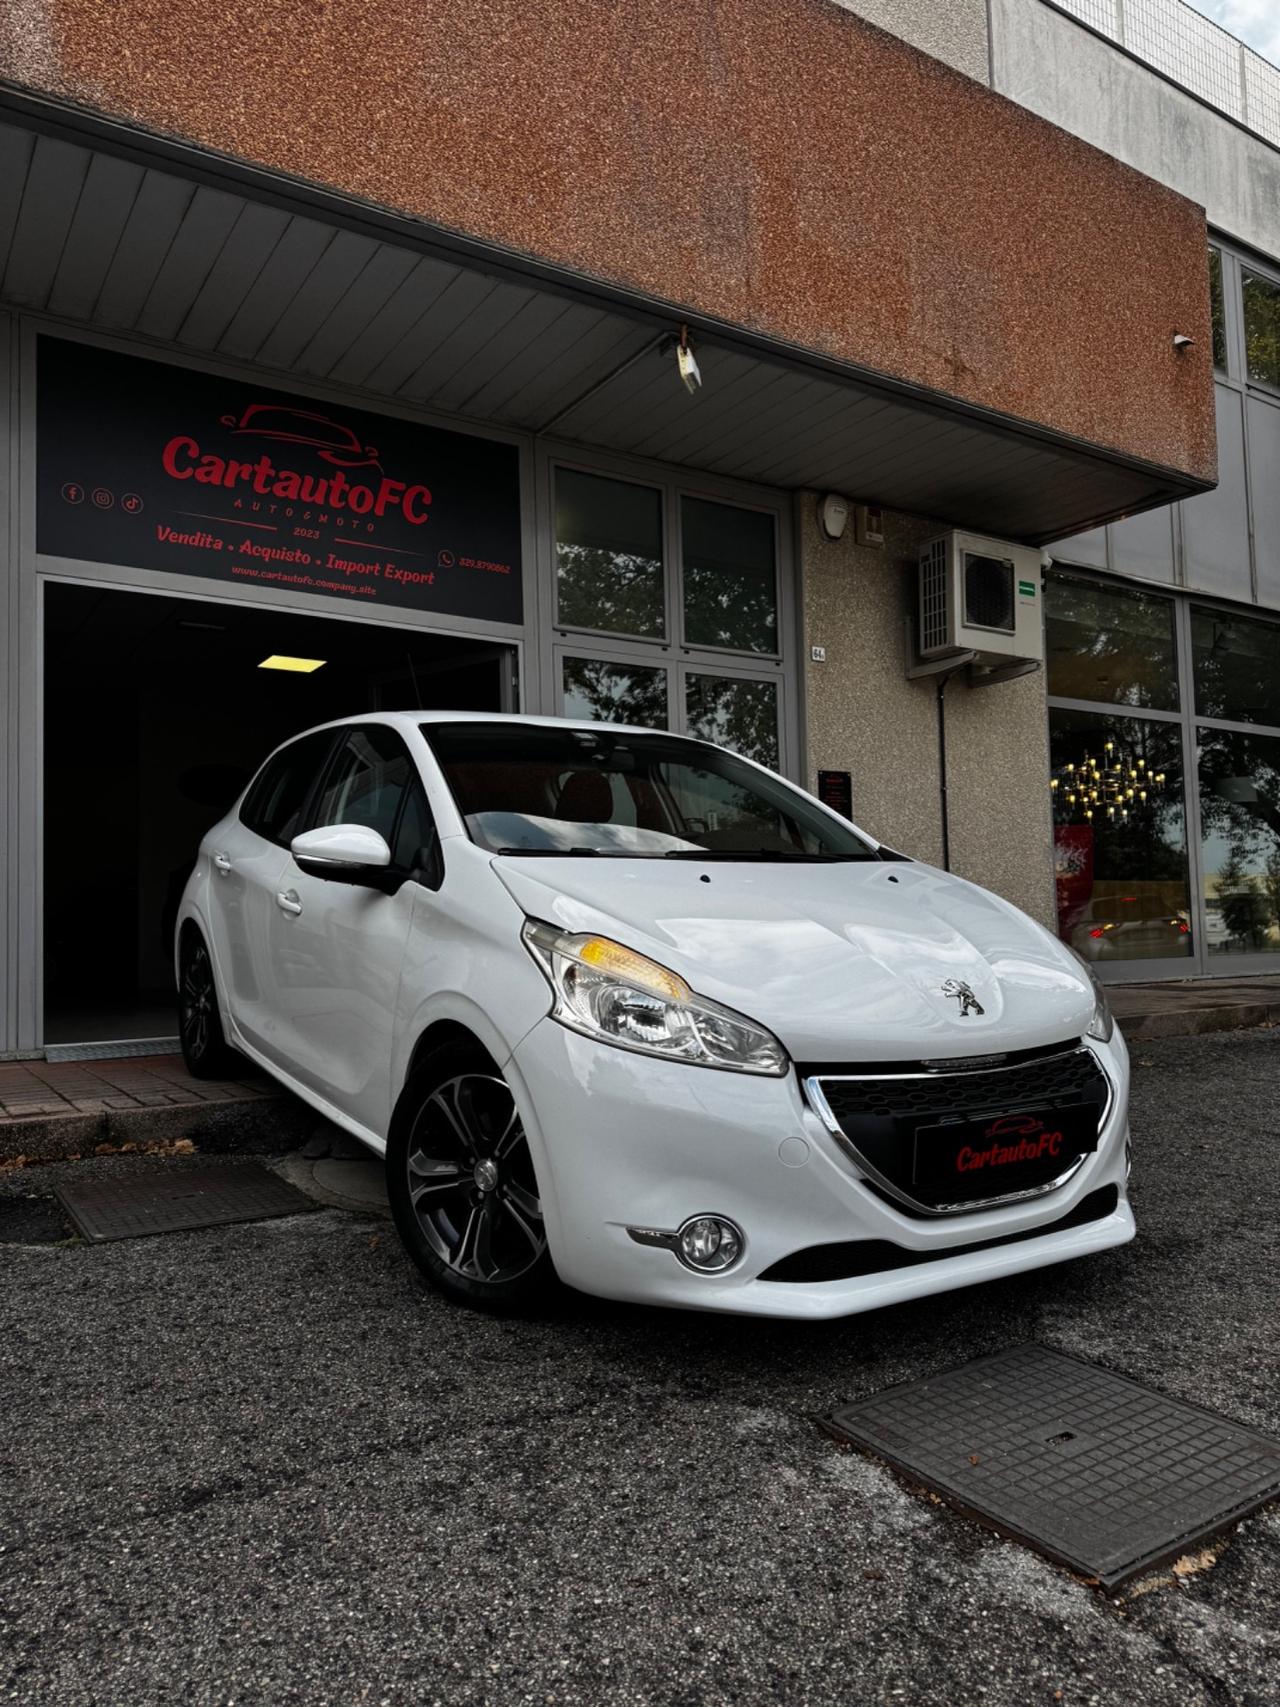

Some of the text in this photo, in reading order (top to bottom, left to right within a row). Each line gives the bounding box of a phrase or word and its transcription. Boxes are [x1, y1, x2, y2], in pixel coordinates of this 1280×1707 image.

[162, 435, 433, 525] CartautoFC
[156, 525, 435, 586] Vendita Acquisto Import Export
[293, 526, 320, 540] 2023
[956, 1130, 1063, 1173] CartautoFC
